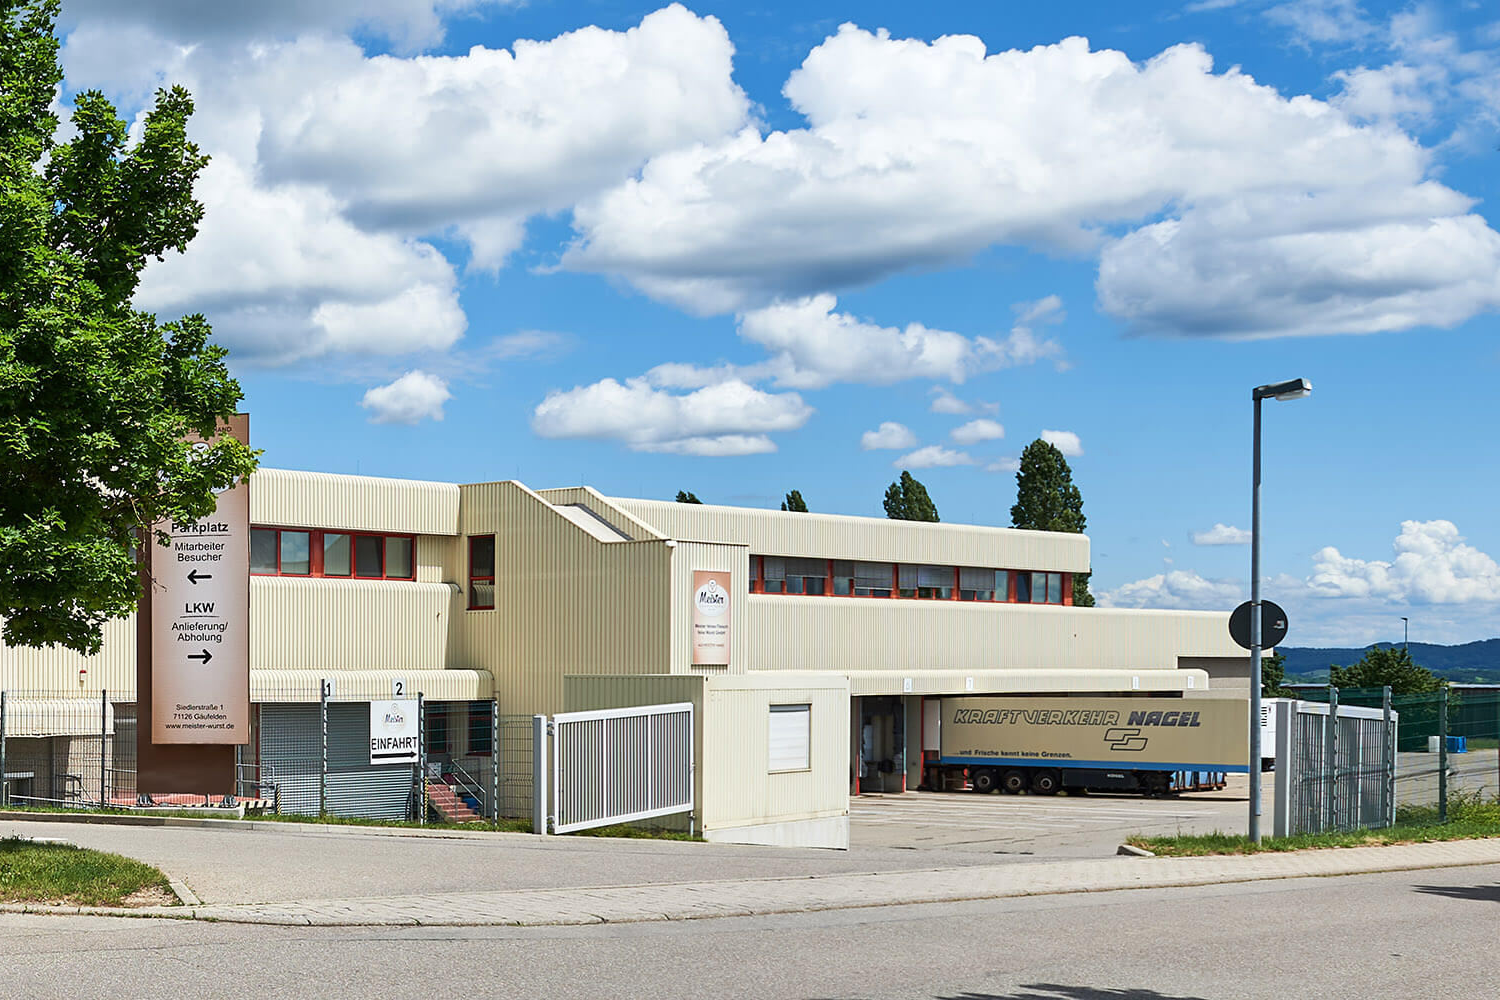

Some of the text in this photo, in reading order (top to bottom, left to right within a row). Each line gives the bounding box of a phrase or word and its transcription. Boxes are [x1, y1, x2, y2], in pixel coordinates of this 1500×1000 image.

[171, 522, 229, 535] Parkplatz
[174, 542, 225, 551] Mitarbeiter
[177, 553, 223, 562] Besucher
[185, 602, 215, 613] LKW
[171, 622, 228, 633] Anlieferung/
[177, 633, 222, 644] Abholung
[326, 682, 331, 696] 1
[395, 682, 403, 695] 2
[953, 709, 1201, 728] KRAFTVERKEHR NAGEL
[371, 736, 418, 751] EINFAHRT
